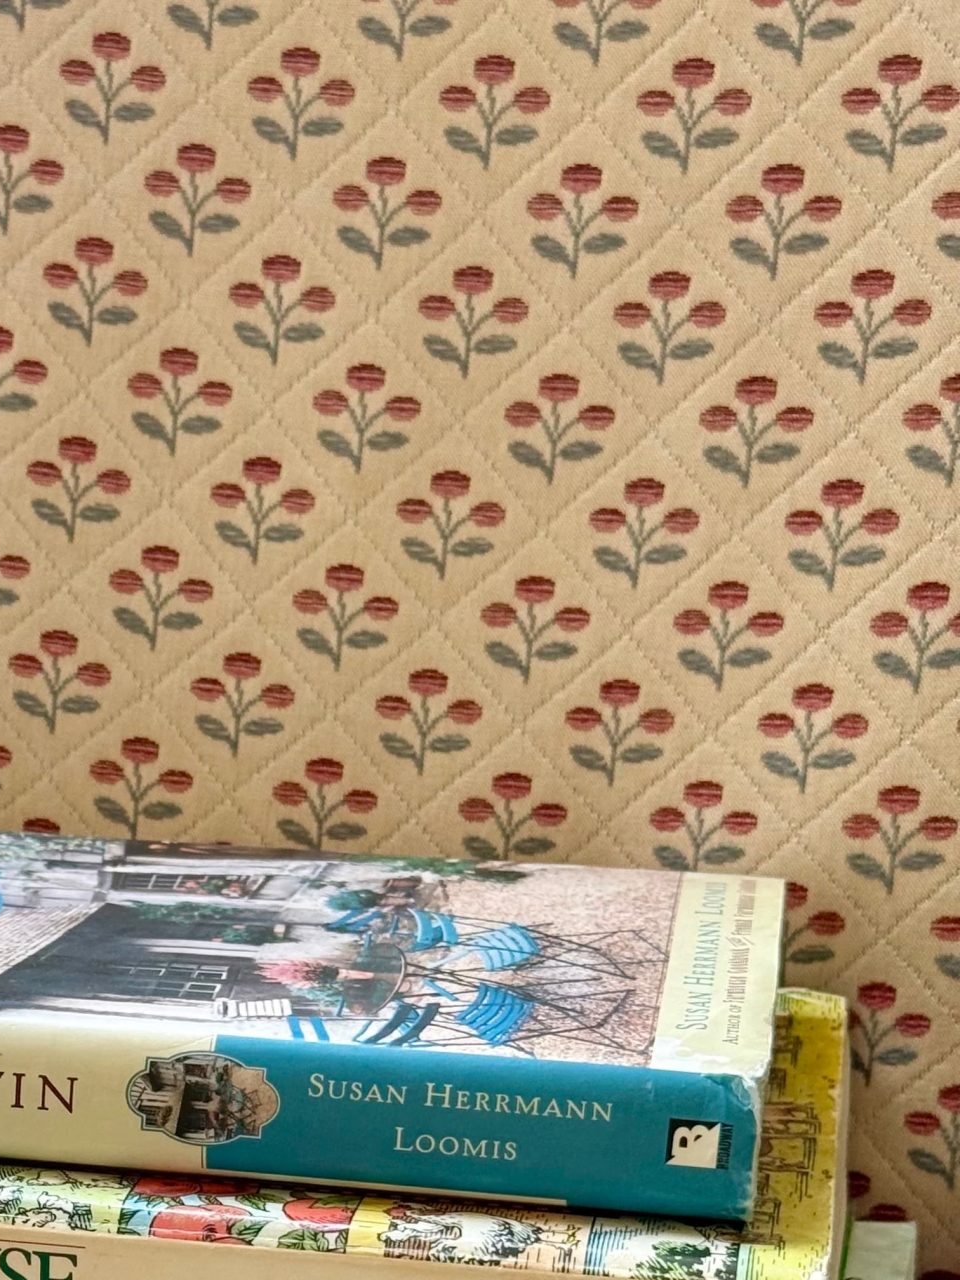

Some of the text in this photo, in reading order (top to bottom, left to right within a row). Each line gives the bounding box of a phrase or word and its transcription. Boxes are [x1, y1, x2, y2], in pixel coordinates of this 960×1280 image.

[683, 920, 722, 987] HERRMANN
[675, 991, 713, 1031] SUSAN
[308, 1072, 613, 1122] SUSAN HERRMANN
[394, 1127, 518, 1160] LOOMIS
